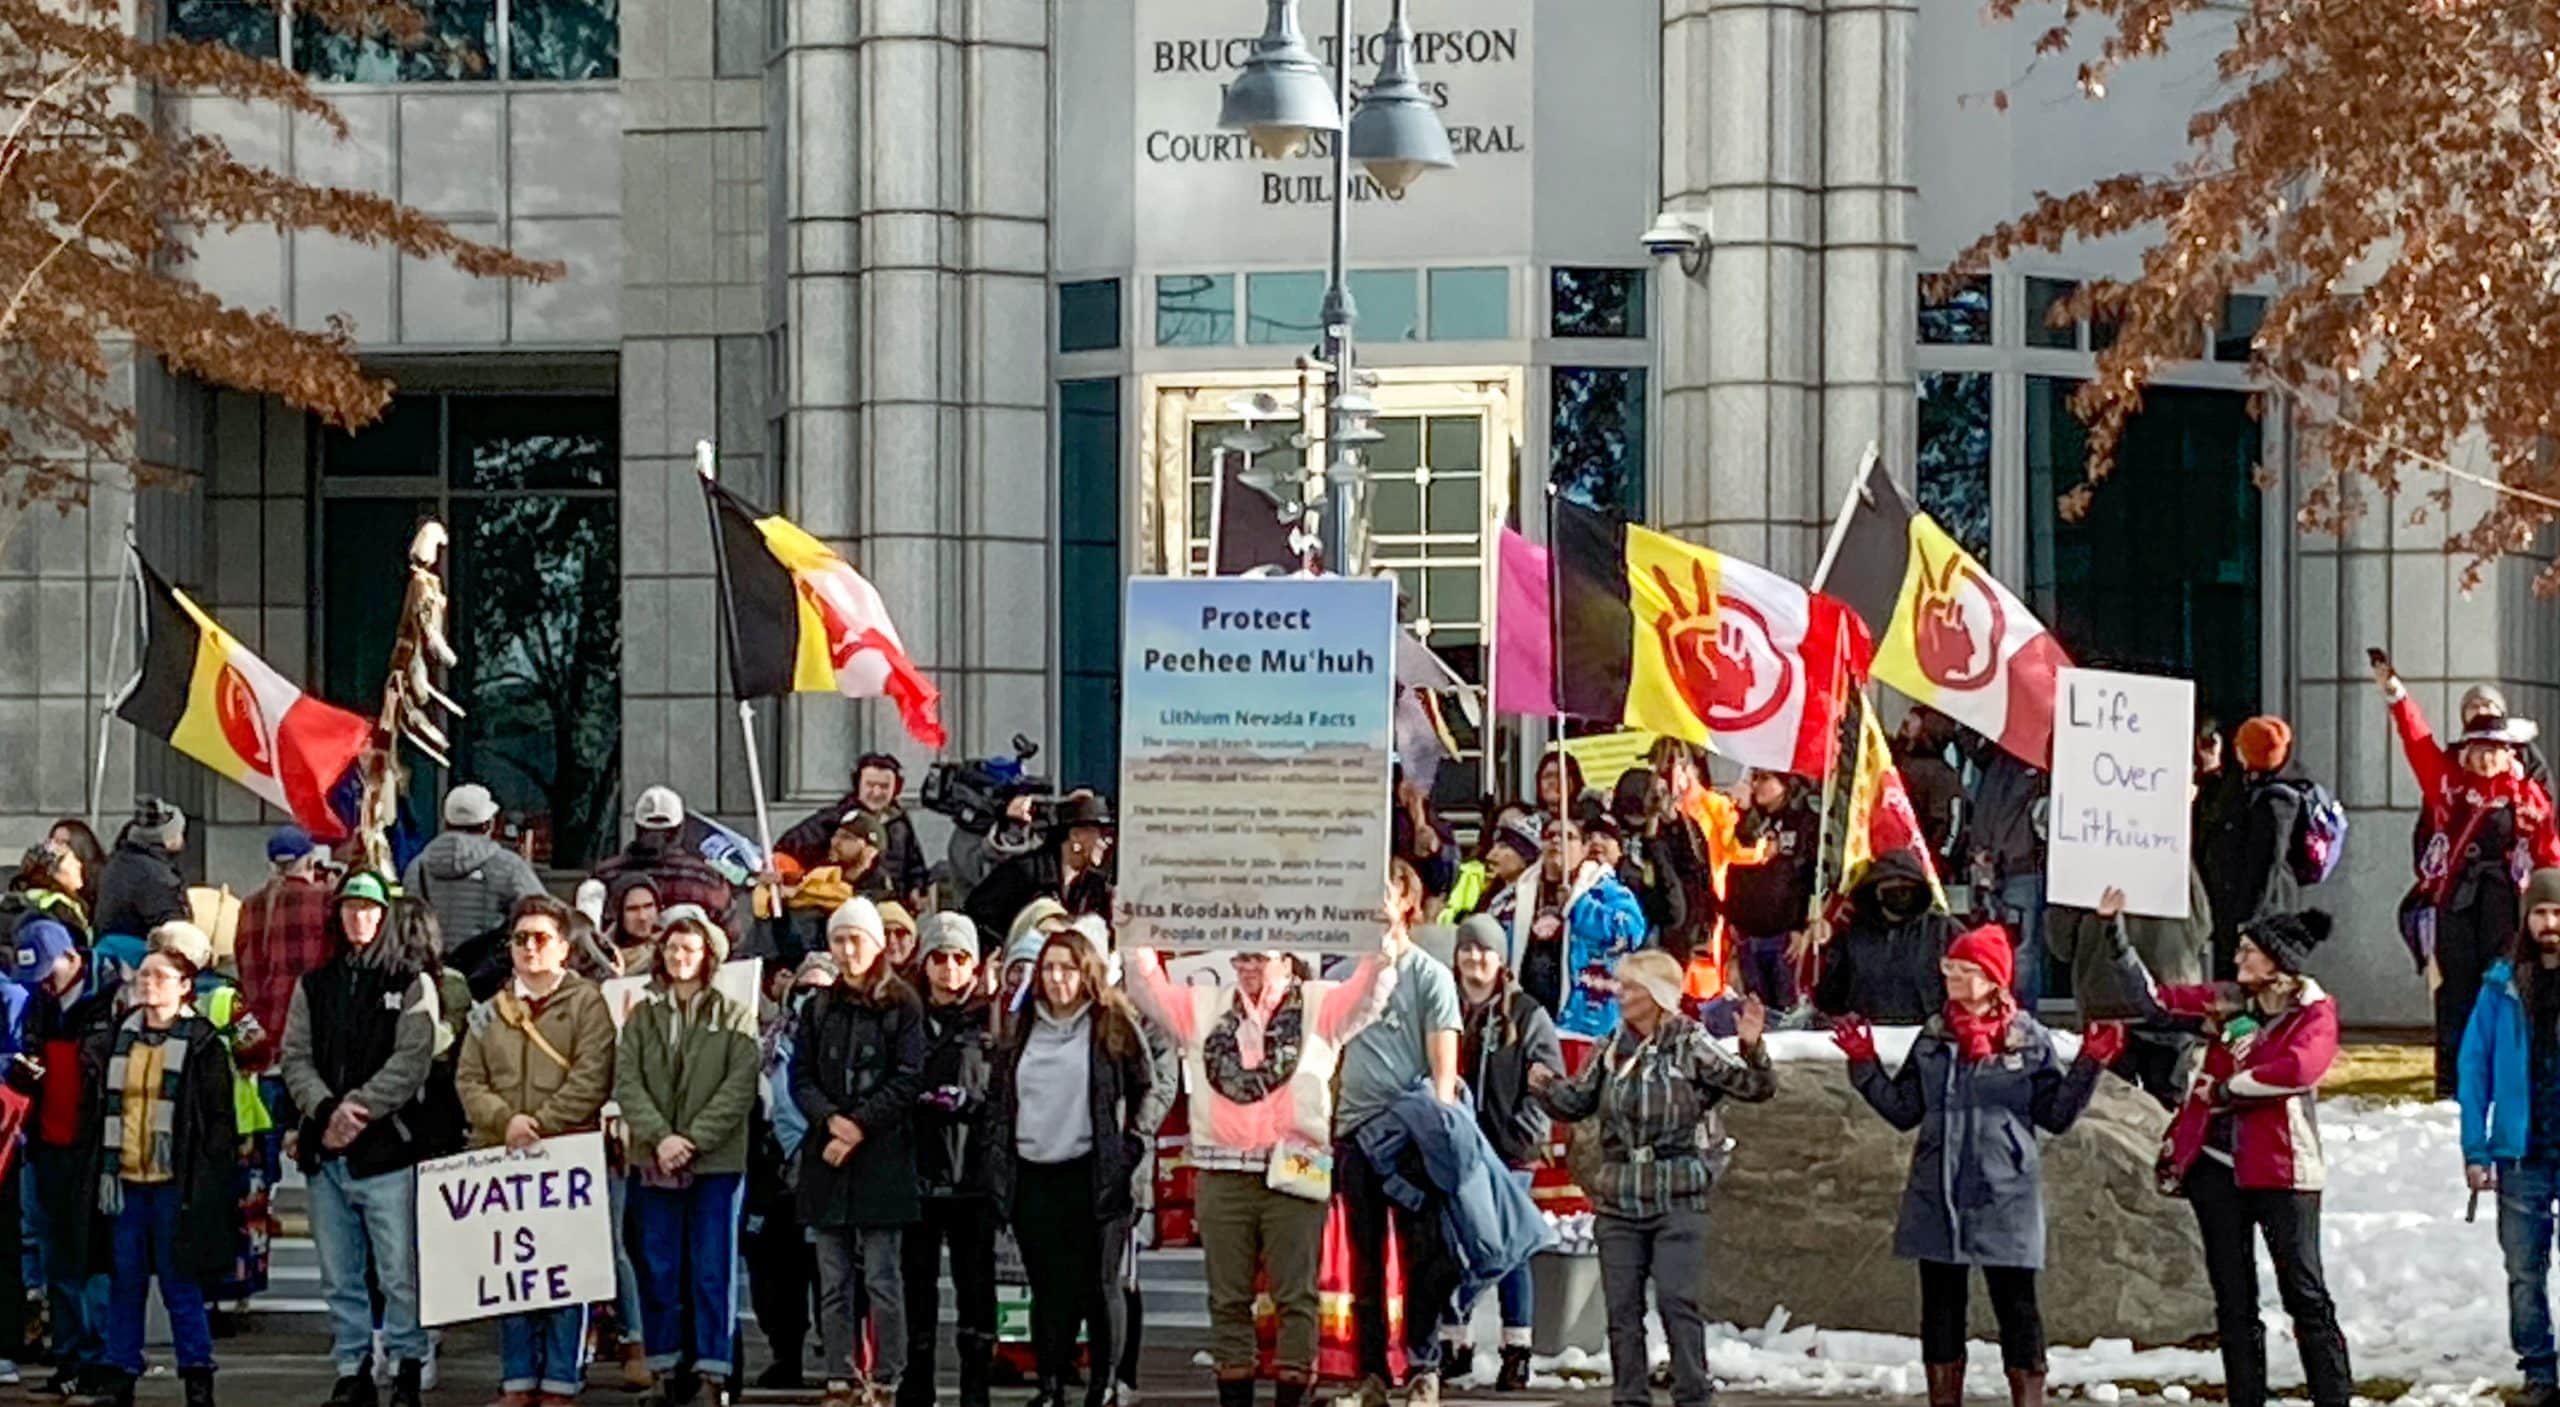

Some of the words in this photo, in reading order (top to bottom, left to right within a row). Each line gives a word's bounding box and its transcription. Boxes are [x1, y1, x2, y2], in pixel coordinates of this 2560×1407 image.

[1153, 38, 1261, 73] BRUC
[1447, 125, 1524, 154] ERAL
[1261, 171, 1406, 204] BUILIN
[1202, 605, 1312, 631] Protect
[1144, 647, 1252, 673] Peehee
[1159, 708, 1230, 726] Lithium
[1235, 709, 1304, 727] Nevada
[1309, 710, 1356, 728] Facts
[2069, 682, 2142, 734] Life
[2093, 752, 2168, 791] Over
[2058, 792, 2179, 854] Lithium
[1171, 902, 1269, 921] Koodakuh
[1274, 904, 1316, 926] wyh
[1150, 924, 1206, 944] People
[1210, 926, 1229, 941] of
[1231, 926, 1263, 942] Red
[1267, 927, 1351, 943] Mountain
[439, 1166, 593, 1222] WATER
[493, 1226, 536, 1266] IS
[477, 1264, 572, 1306] LIFE
